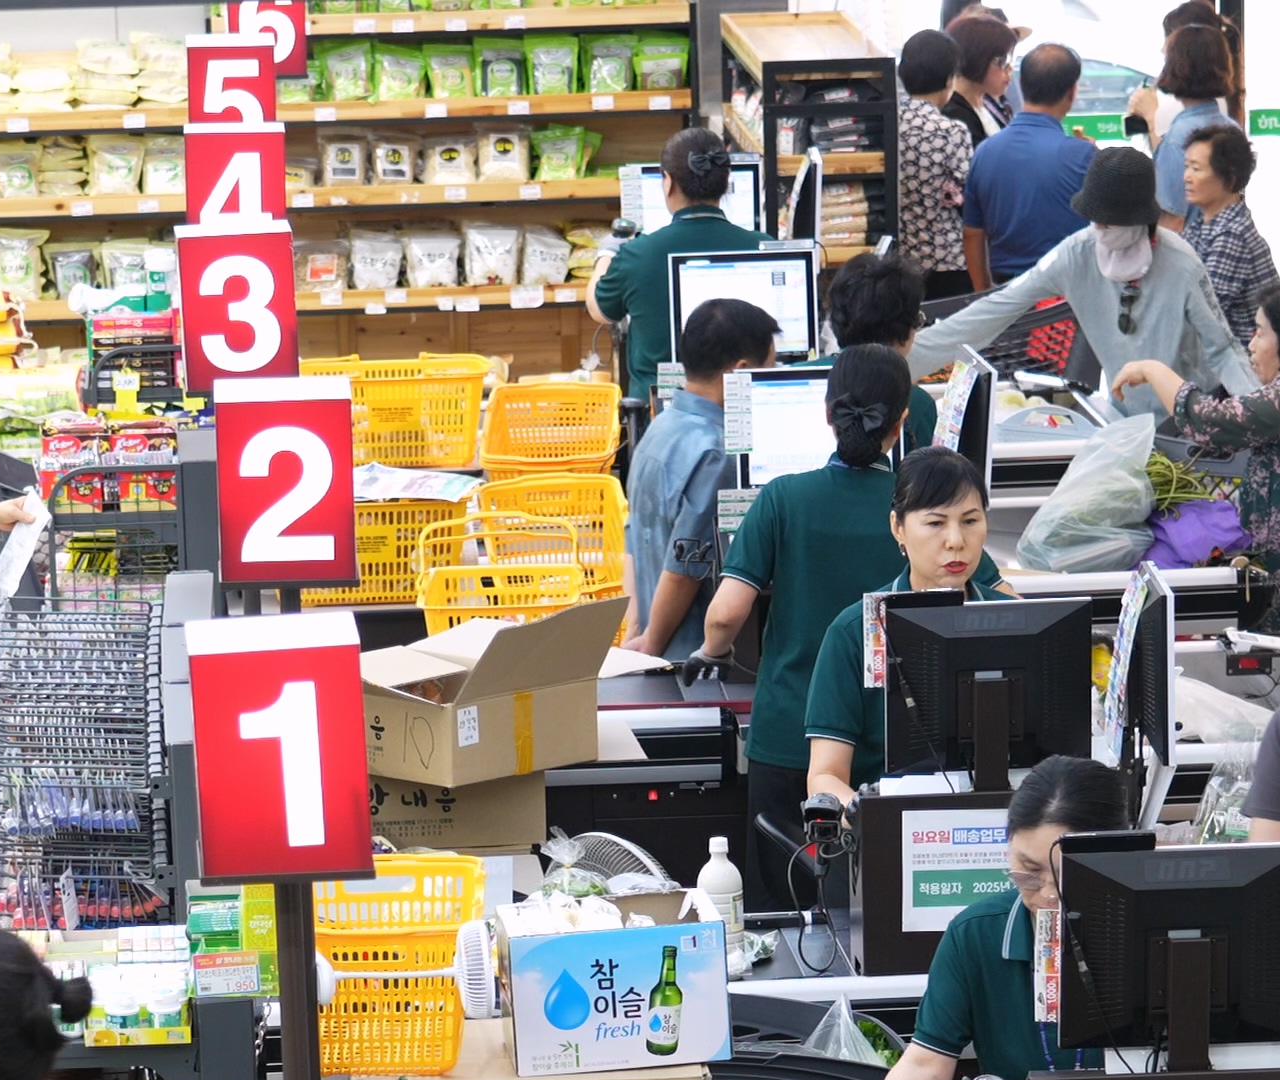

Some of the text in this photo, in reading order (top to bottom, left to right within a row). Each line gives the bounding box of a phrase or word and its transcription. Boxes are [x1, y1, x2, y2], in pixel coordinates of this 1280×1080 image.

[238, 0, 296, 64] 6
[203, 59, 265, 123] 5
[200, 152, 273, 225] 4
[199, 255, 282, 373] 3
[238, 425, 336, 563] 2
[239, 681, 326, 847] 1
[912, 828, 1007, 844] 일요일 배송업무
[919, 880, 1011, 895] 적용일자 2025년
[590, 958, 620, 991] 참
[593, 986, 646, 1019] 이슬
[595, 1020, 641, 1042] fresh
[661, 1024, 678, 1035] 이슬
